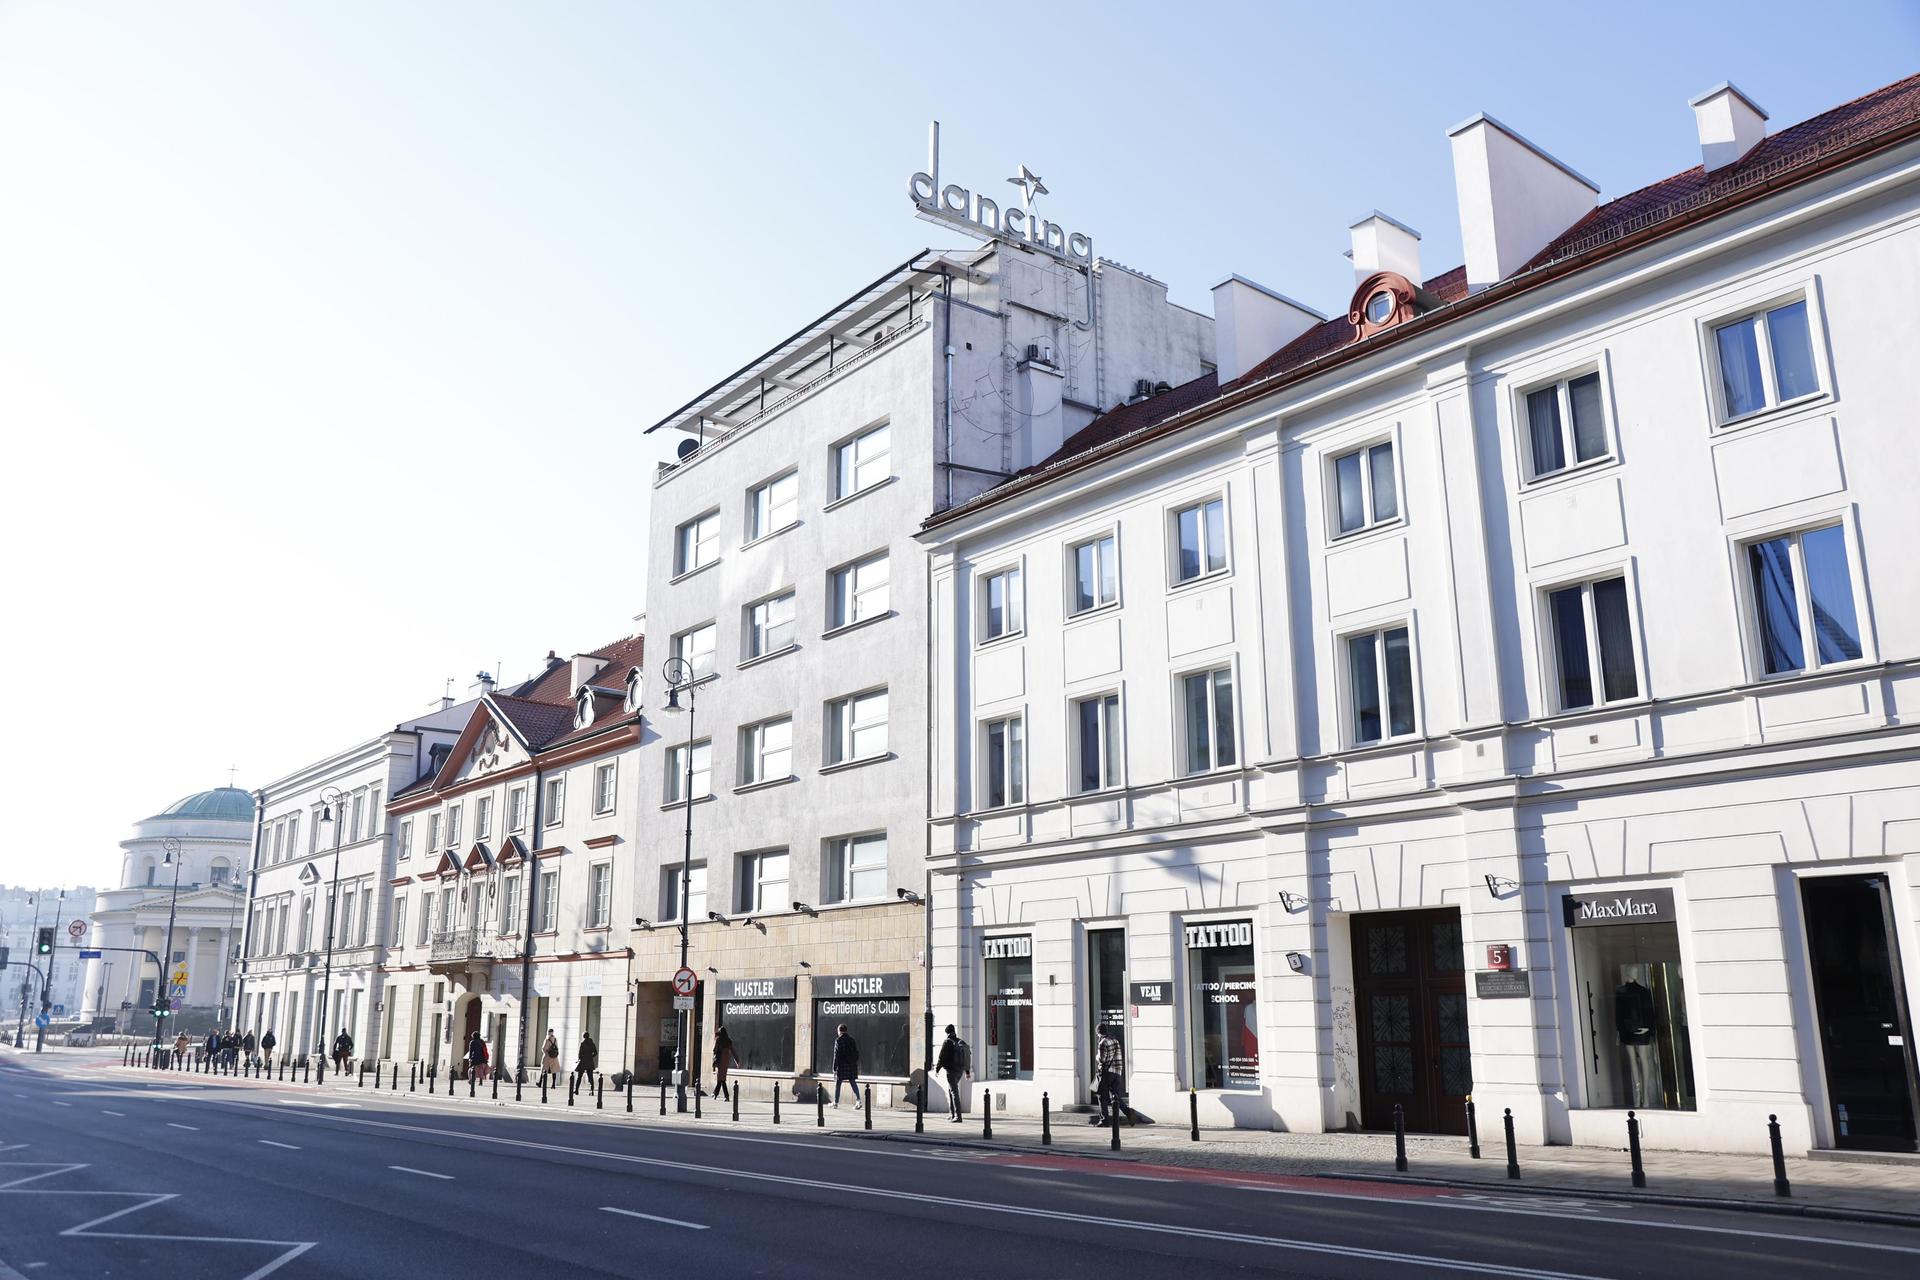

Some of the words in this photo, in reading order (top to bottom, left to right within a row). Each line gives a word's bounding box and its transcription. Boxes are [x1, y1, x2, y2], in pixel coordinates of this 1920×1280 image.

[907, 120, 1094, 331] dancing
[1581, 898, 1657, 919] MaxMara
[1186, 923, 1252, 948] TATTOO
[984, 937, 1031, 958] TATTOO
[1494, 951, 1502, 964] 5
[734, 982, 774, 996] HUSTLER
[834, 978, 883, 994] HUSTLER
[1193, 982, 1219, 991] TATTOO
[1225, 981, 1256, 990] PIERCING
[1211, 995, 1239, 1003] SCHOOL
[726, 1003, 770, 1014] Gentlemen's
[771, 1002, 789, 1014] Club
[823, 1001, 876, 1014] Gentlemen's
[878, 1000, 900, 1014] Club
